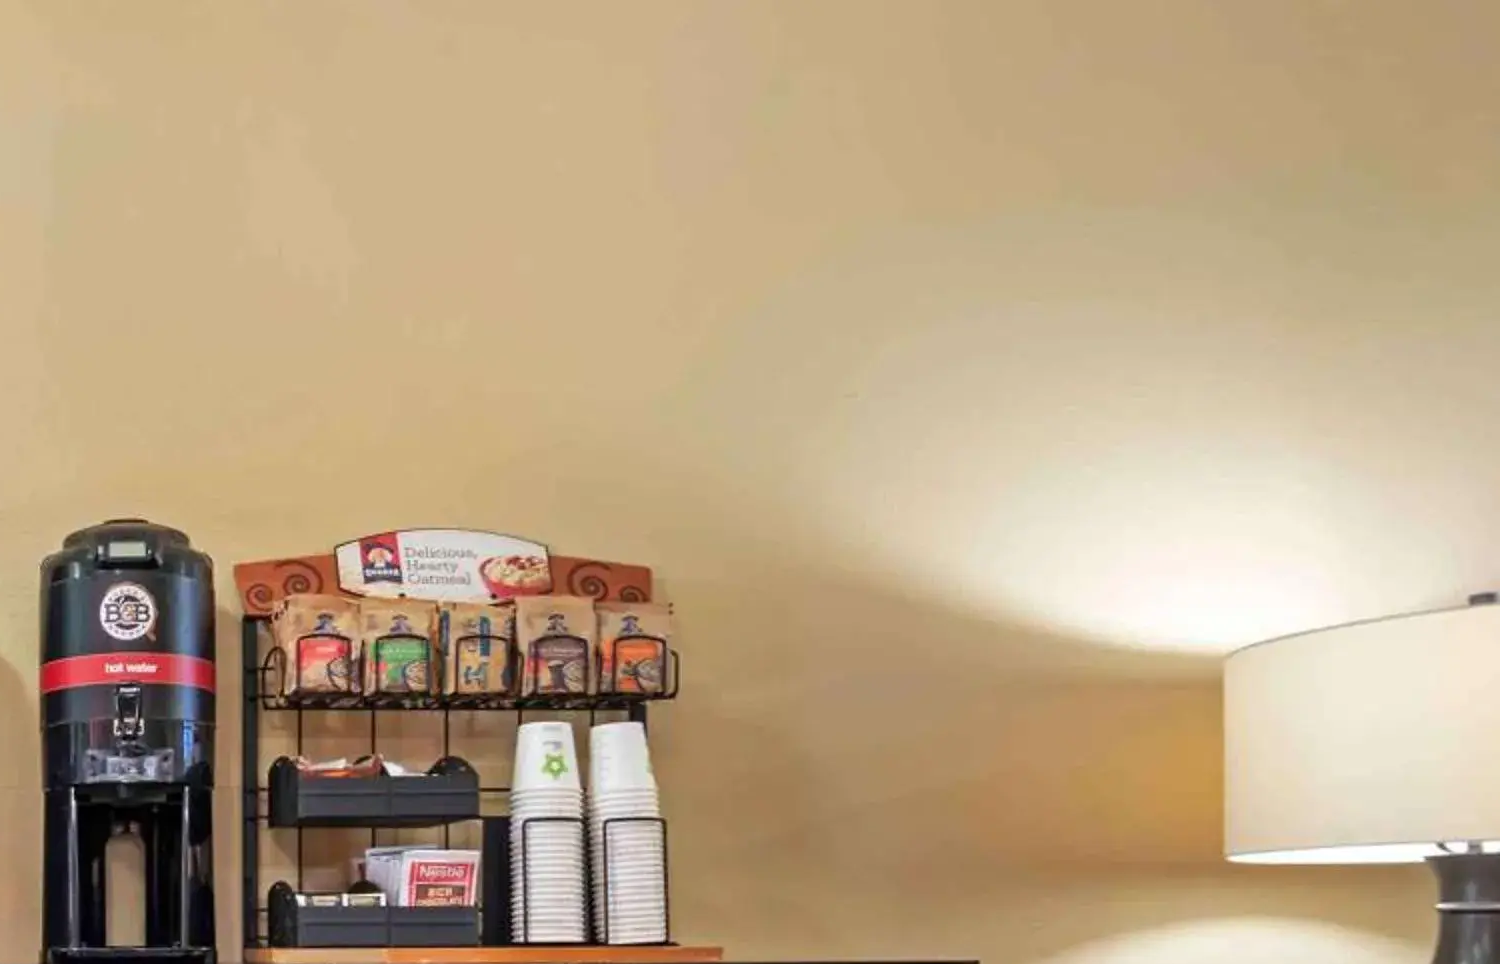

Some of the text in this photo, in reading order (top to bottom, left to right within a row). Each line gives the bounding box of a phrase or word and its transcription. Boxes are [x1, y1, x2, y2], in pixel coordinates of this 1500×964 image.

[404, 546, 478, 560] Delicious,
[407, 559, 458, 573] Hearty
[408, 572, 471, 585] Oatmeal
